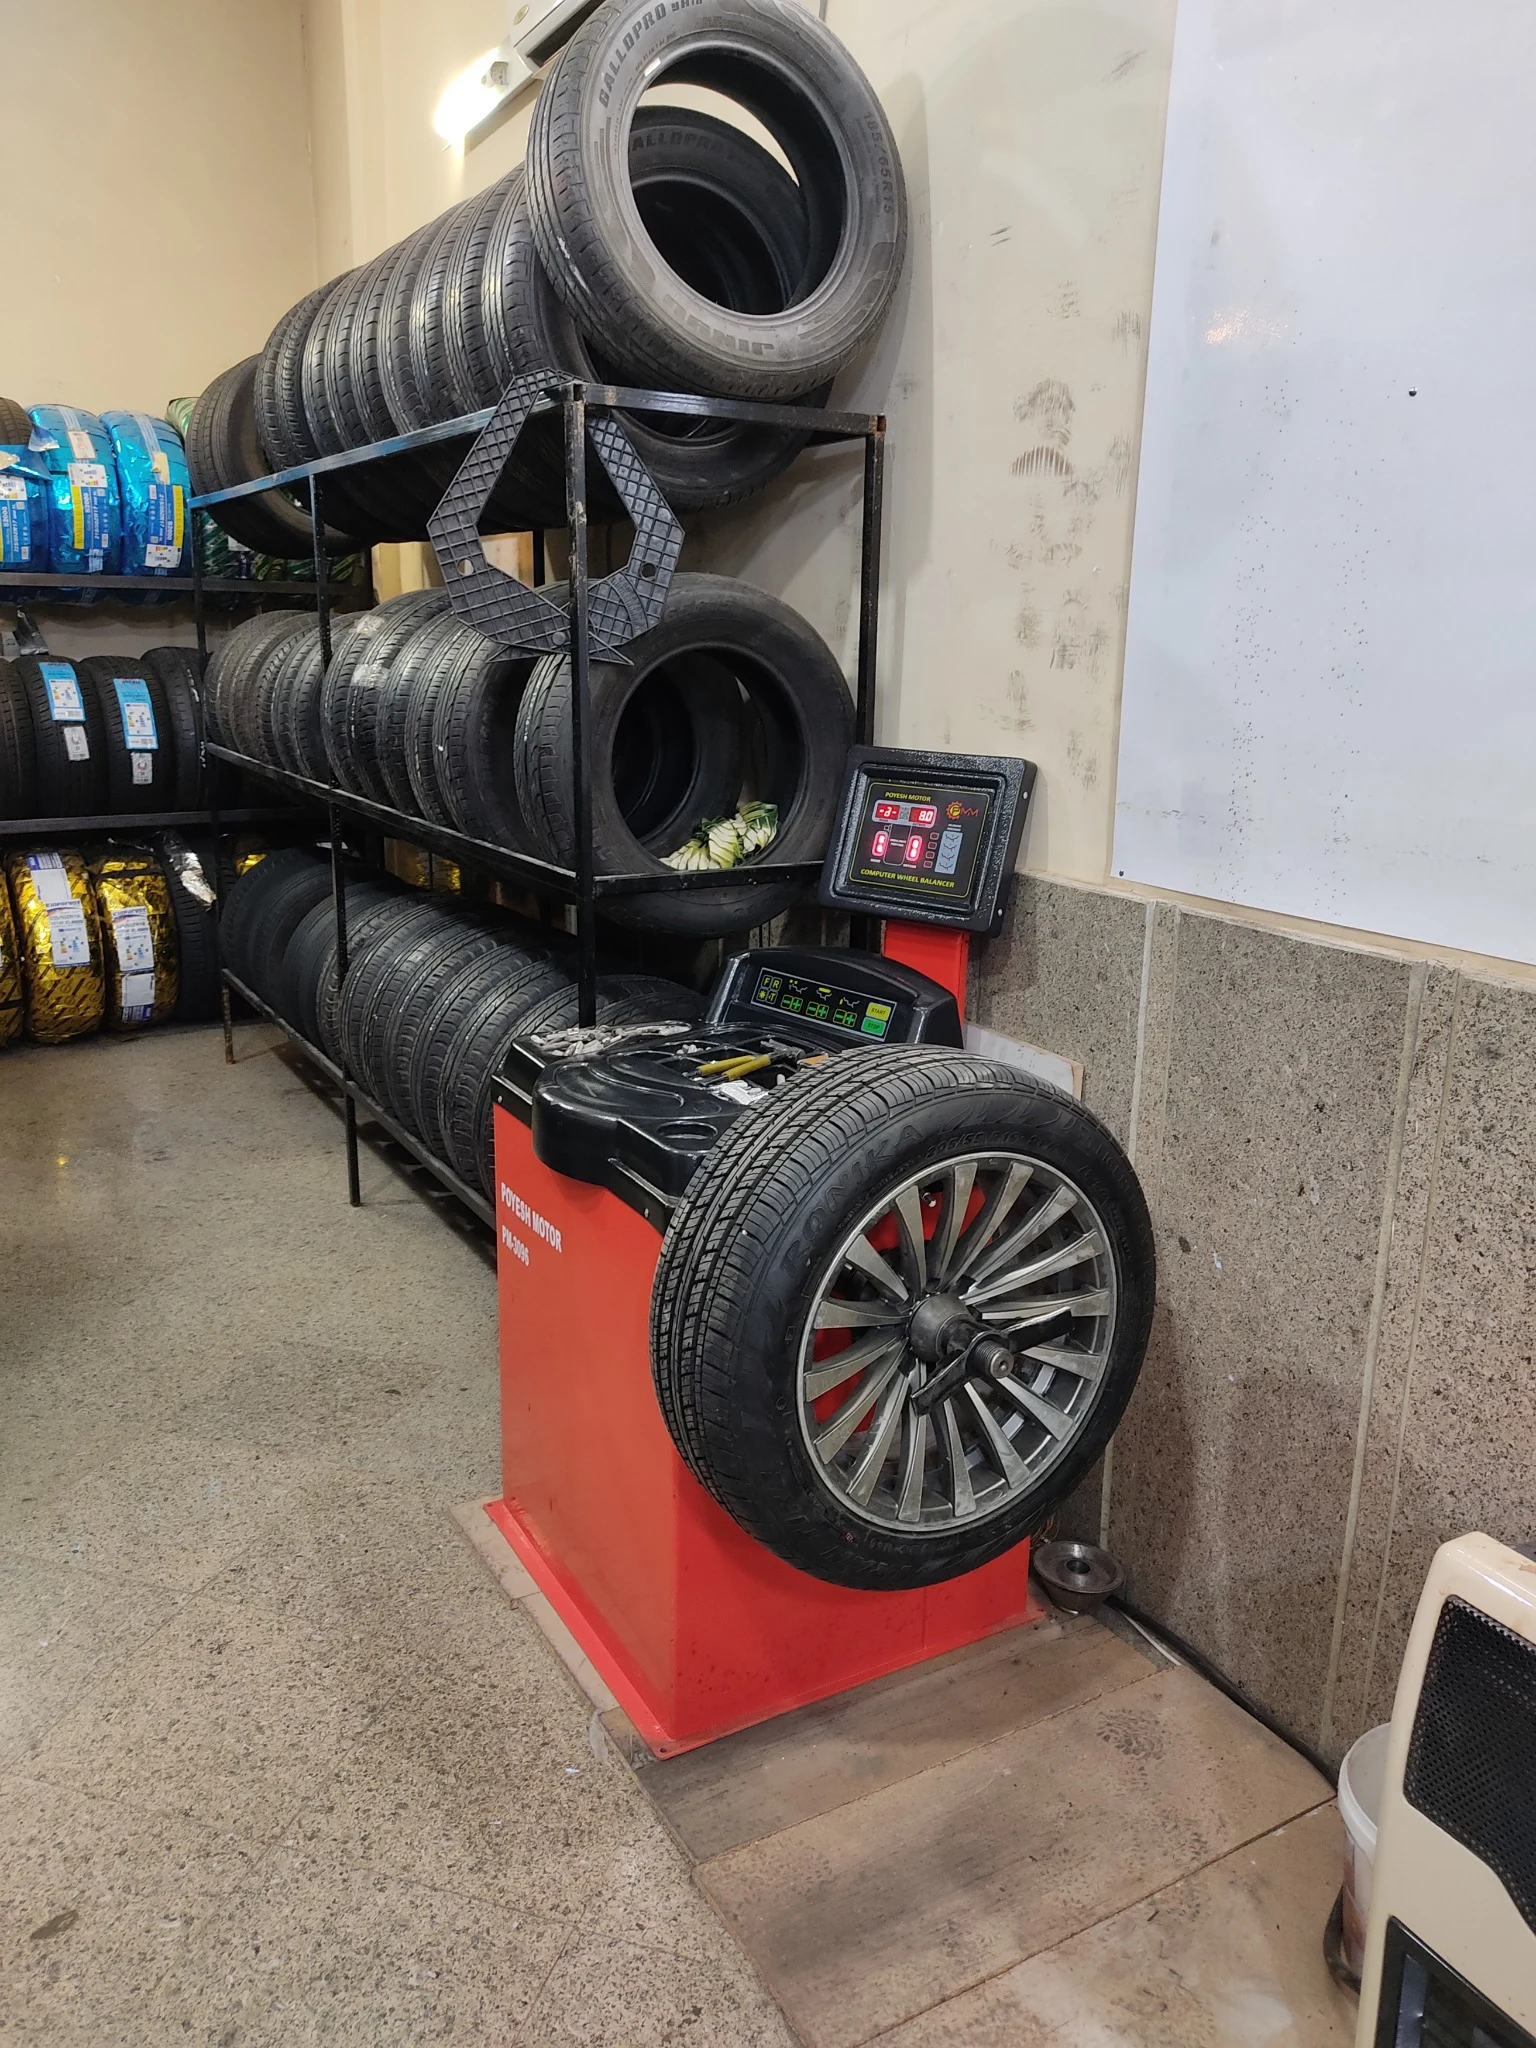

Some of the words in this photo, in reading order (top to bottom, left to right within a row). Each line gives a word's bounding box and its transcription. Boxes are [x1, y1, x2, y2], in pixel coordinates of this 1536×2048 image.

[598, 2, 667, 109] GALLOPRO
[885, 791, 908, 800] POYESH
[908, 793, 932, 803] MOTOR
[860, 868, 896, 880] COMPUTER
[897, 873, 920, 883] WHEEL
[920, 876, 955, 888] BALANCER
[763, 976, 770, 986] F
[772, 979, 780, 988] R
[871, 1007, 887, 1015] START
[780, 1124, 924, 1279] RONIKA
[500, 1181, 531, 1228] POYESH
[532, 1210, 563, 1254] MOTOR
